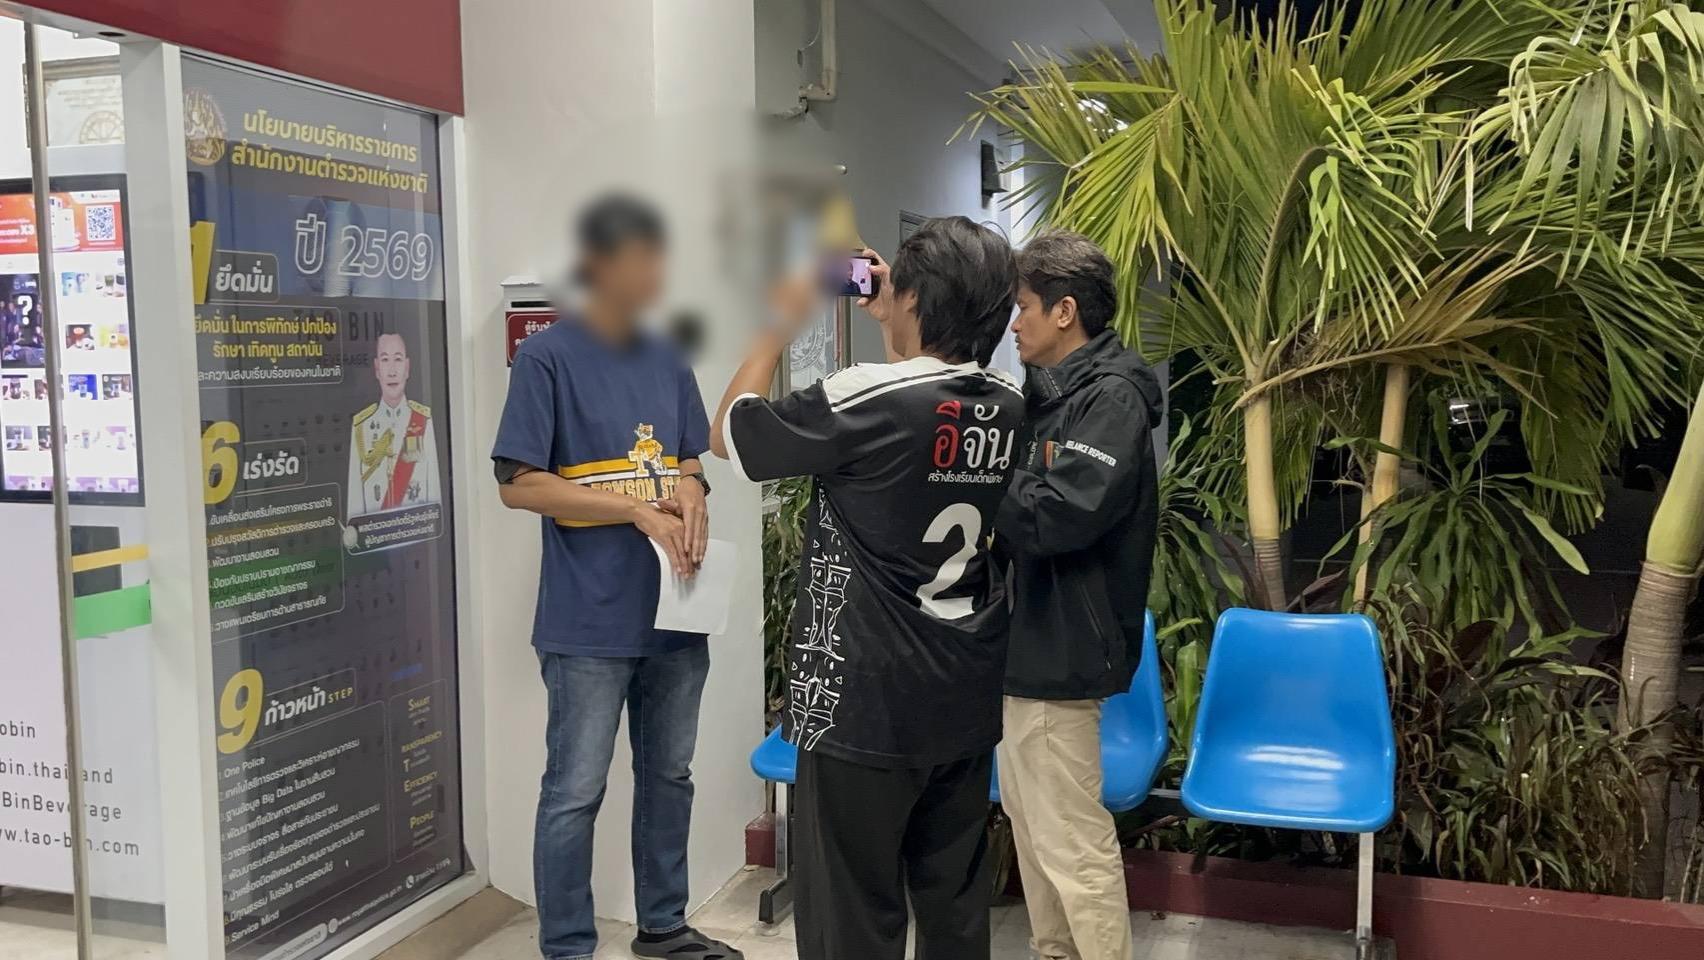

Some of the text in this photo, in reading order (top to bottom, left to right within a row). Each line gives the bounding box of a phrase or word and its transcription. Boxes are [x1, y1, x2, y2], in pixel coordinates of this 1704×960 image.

[244, 108, 417, 163] นโยบายบริหารราชการ
[231, 139, 428, 193] สำนักงานตำรวจแห่งชาติ
[295, 213, 434, 281] ปี 2569
[215, 260, 274, 295] ยึดมั่น
[231, 314, 300, 334] ในการพิทักษ์
[302, 317, 337, 334] ปกป้อง
[213, 339, 323, 363] รักษา เทิดทูน สถาบัน
[198, 364, 342, 381] ละความสงบเรียบร้อยของคนในชาติ
[932, 400, 1014, 470] อีจัน
[201, 420, 240, 505] 6
[243, 451, 299, 480] เร่งรัด
[1087, 446, 1117, 467] REPORTER
[661, 476, 681, 500] ST
[928, 470, 1004, 484] สร้างโรงเรียนเด็กพิเศษ
[915, 502, 982, 620] 2
[217, 668, 264, 754] 9
[264, 686, 354, 726] ก้าวหน้า STEP
[0, 758, 113, 784] bin.thaiand
[224, 756, 266, 779] One Police
[2, 791, 122, 822] BinBevage
[262, 793, 275, 807] Big
[276, 785, 294, 799] Data
[0, 828, 140, 856] w.tao-bn.com
[231, 921, 260, 942] Service
[260, 910, 280, 927] Mind
